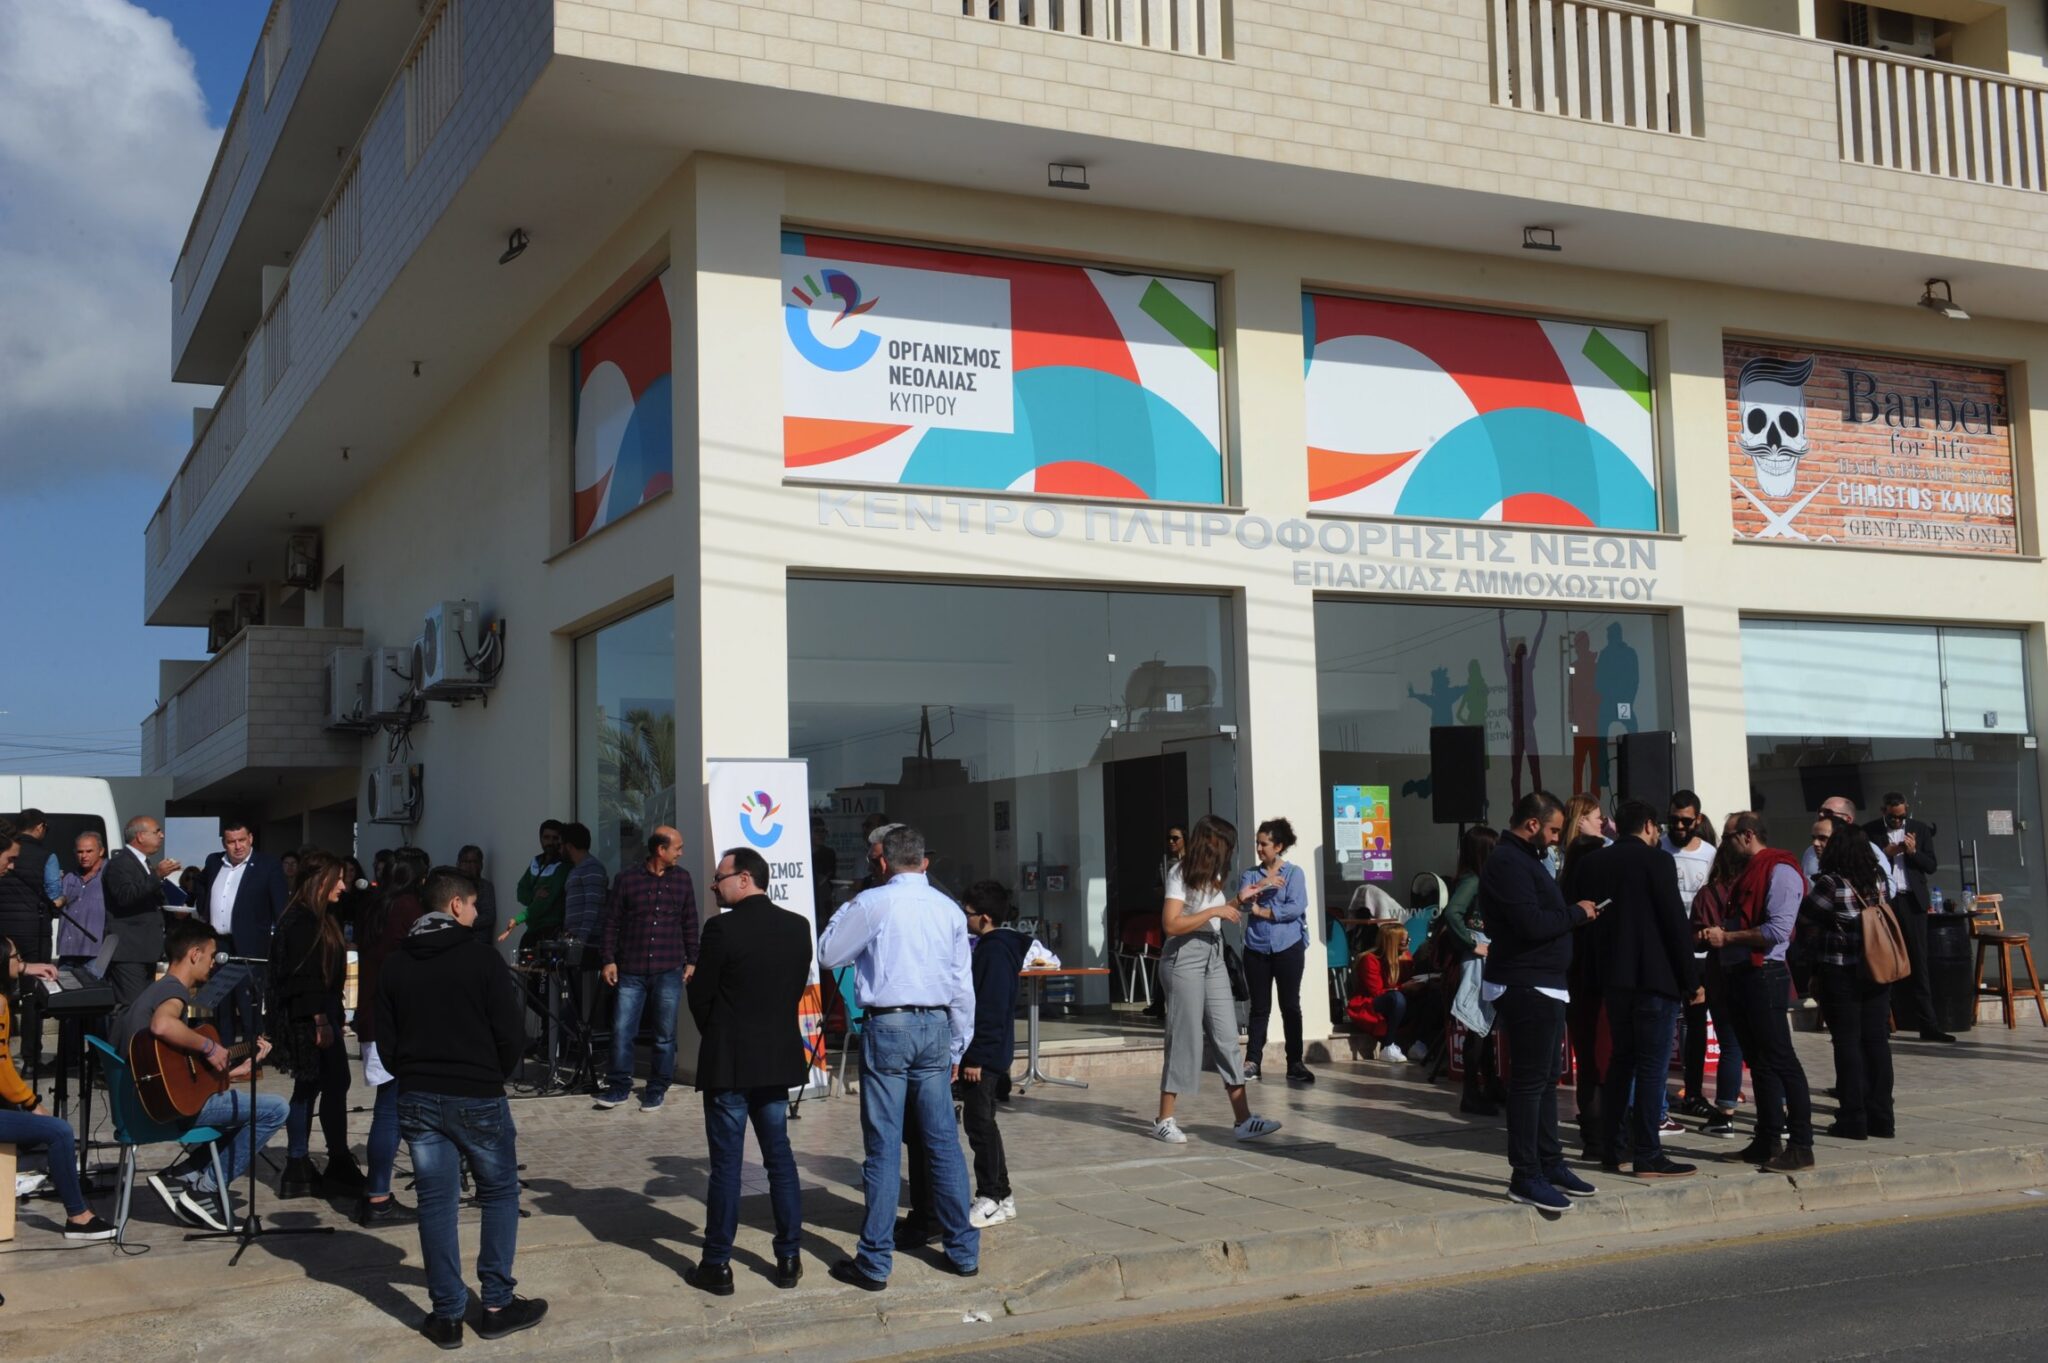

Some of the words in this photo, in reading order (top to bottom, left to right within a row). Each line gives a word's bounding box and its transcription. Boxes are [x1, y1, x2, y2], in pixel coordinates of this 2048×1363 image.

[888, 340, 1001, 370] ΟΡΓΑΝΙΣΜΟΣ
[889, 365, 977, 392] ΝΕΟΛΑΙΑΣ
[889, 391, 957, 417] ΚΥΠΡΟΥ
[1840, 367, 2002, 436] Barber
[1891, 433, 1925, 457] for
[1933, 435, 1971, 461] life
[1838, 458, 1880, 476] HAIR
[1899, 463, 1954, 481] BEARD
[1960, 469, 2011, 486] STYLE
[1837, 481, 1934, 512] CHRISTOS
[1940, 490, 2013, 517] KAIKKIS
[817, 489, 1065, 538] ΚΕΝΤΡΟ
[1085, 506, 1516, 563] ΠΛΗΡΟΦΟΡΗΣΗΣ
[1530, 534, 1658, 571] ΝΕΩΝ
[1849, 519, 1966, 542] GENTLEMENS
[1969, 527, 2012, 545] ONLY
[1292, 559, 1448, 594] ΕΠΑΡΧΙΑΣ
[1454, 567, 1658, 602] ΑΜΜΟΧΩΣΤΟΥ
[1620, 704, 1629, 719] 2
